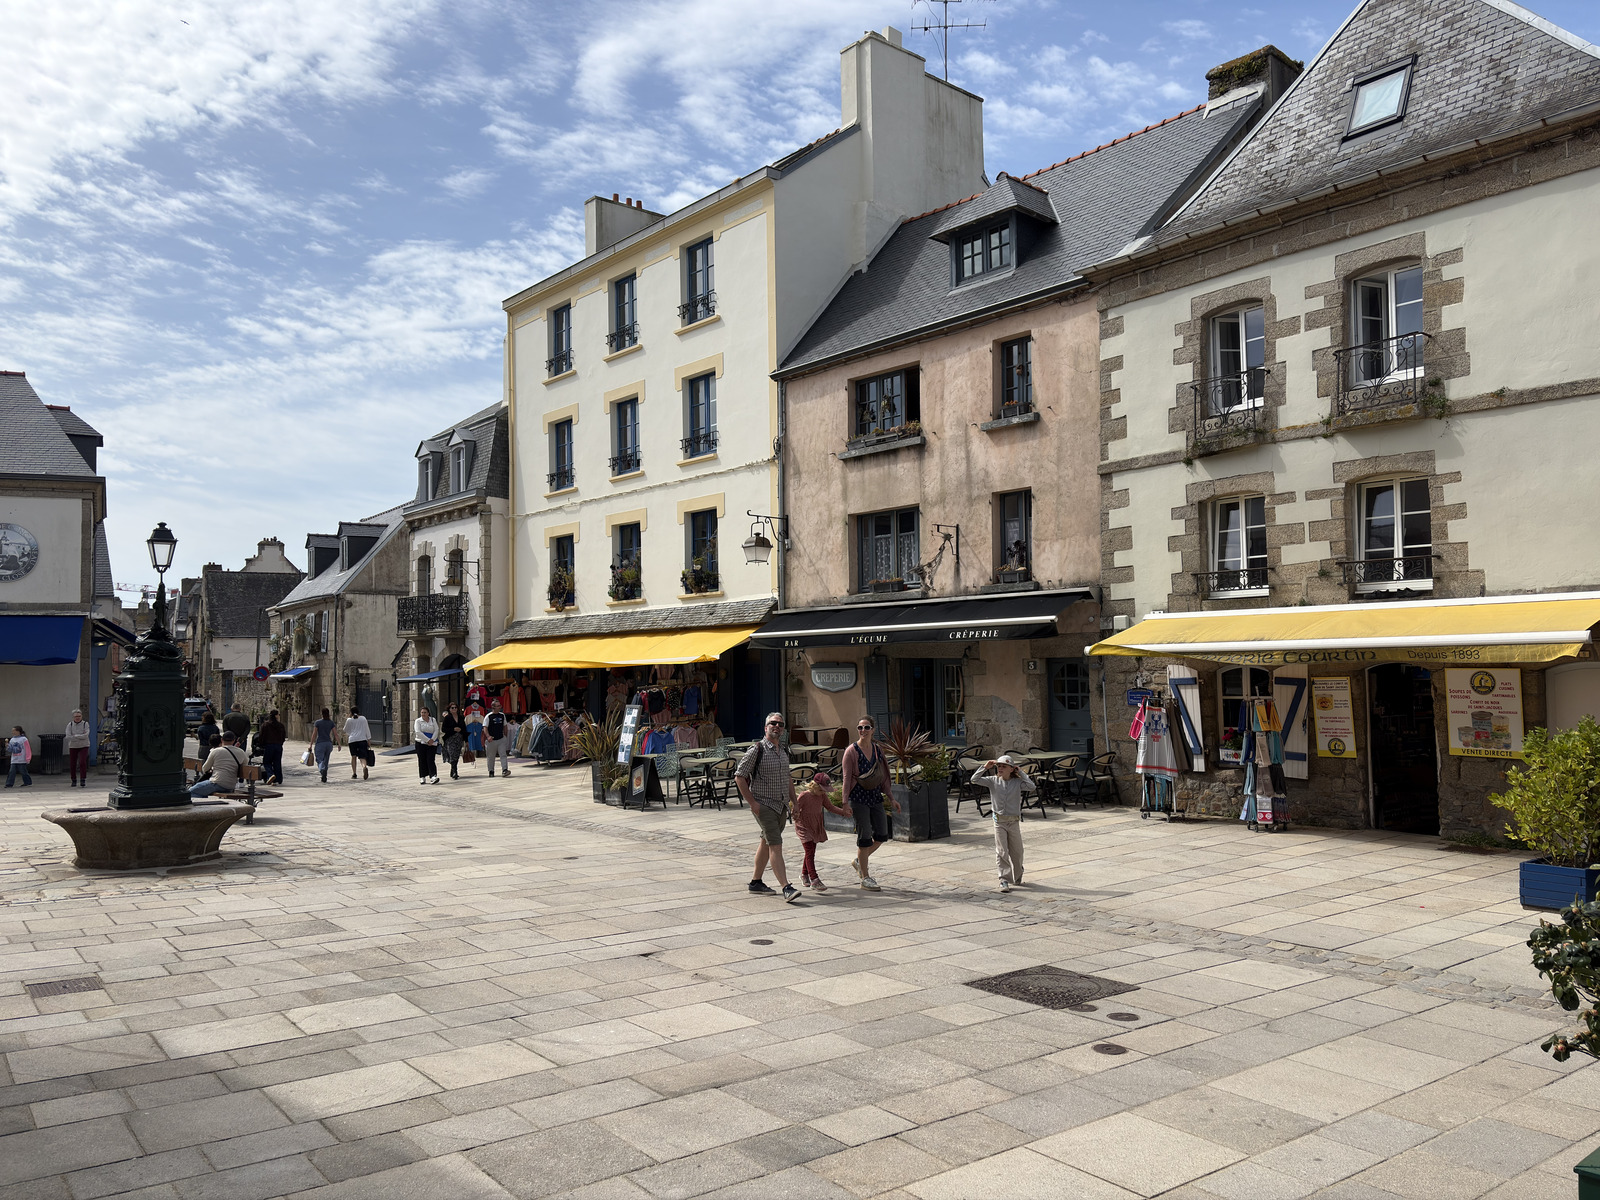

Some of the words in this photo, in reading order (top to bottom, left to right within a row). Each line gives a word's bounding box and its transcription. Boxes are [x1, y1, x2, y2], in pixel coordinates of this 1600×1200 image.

[850, 635, 888, 644] L'ÉCUME
[949, 629, 1000, 640] CRÊPERIE
[1407, 650, 1448, 661] Depuis
[1451, 649, 1481, 660] 1893
[1028, 661, 1035, 670] 3
[1484, 749, 1513, 757] DIRECTE
